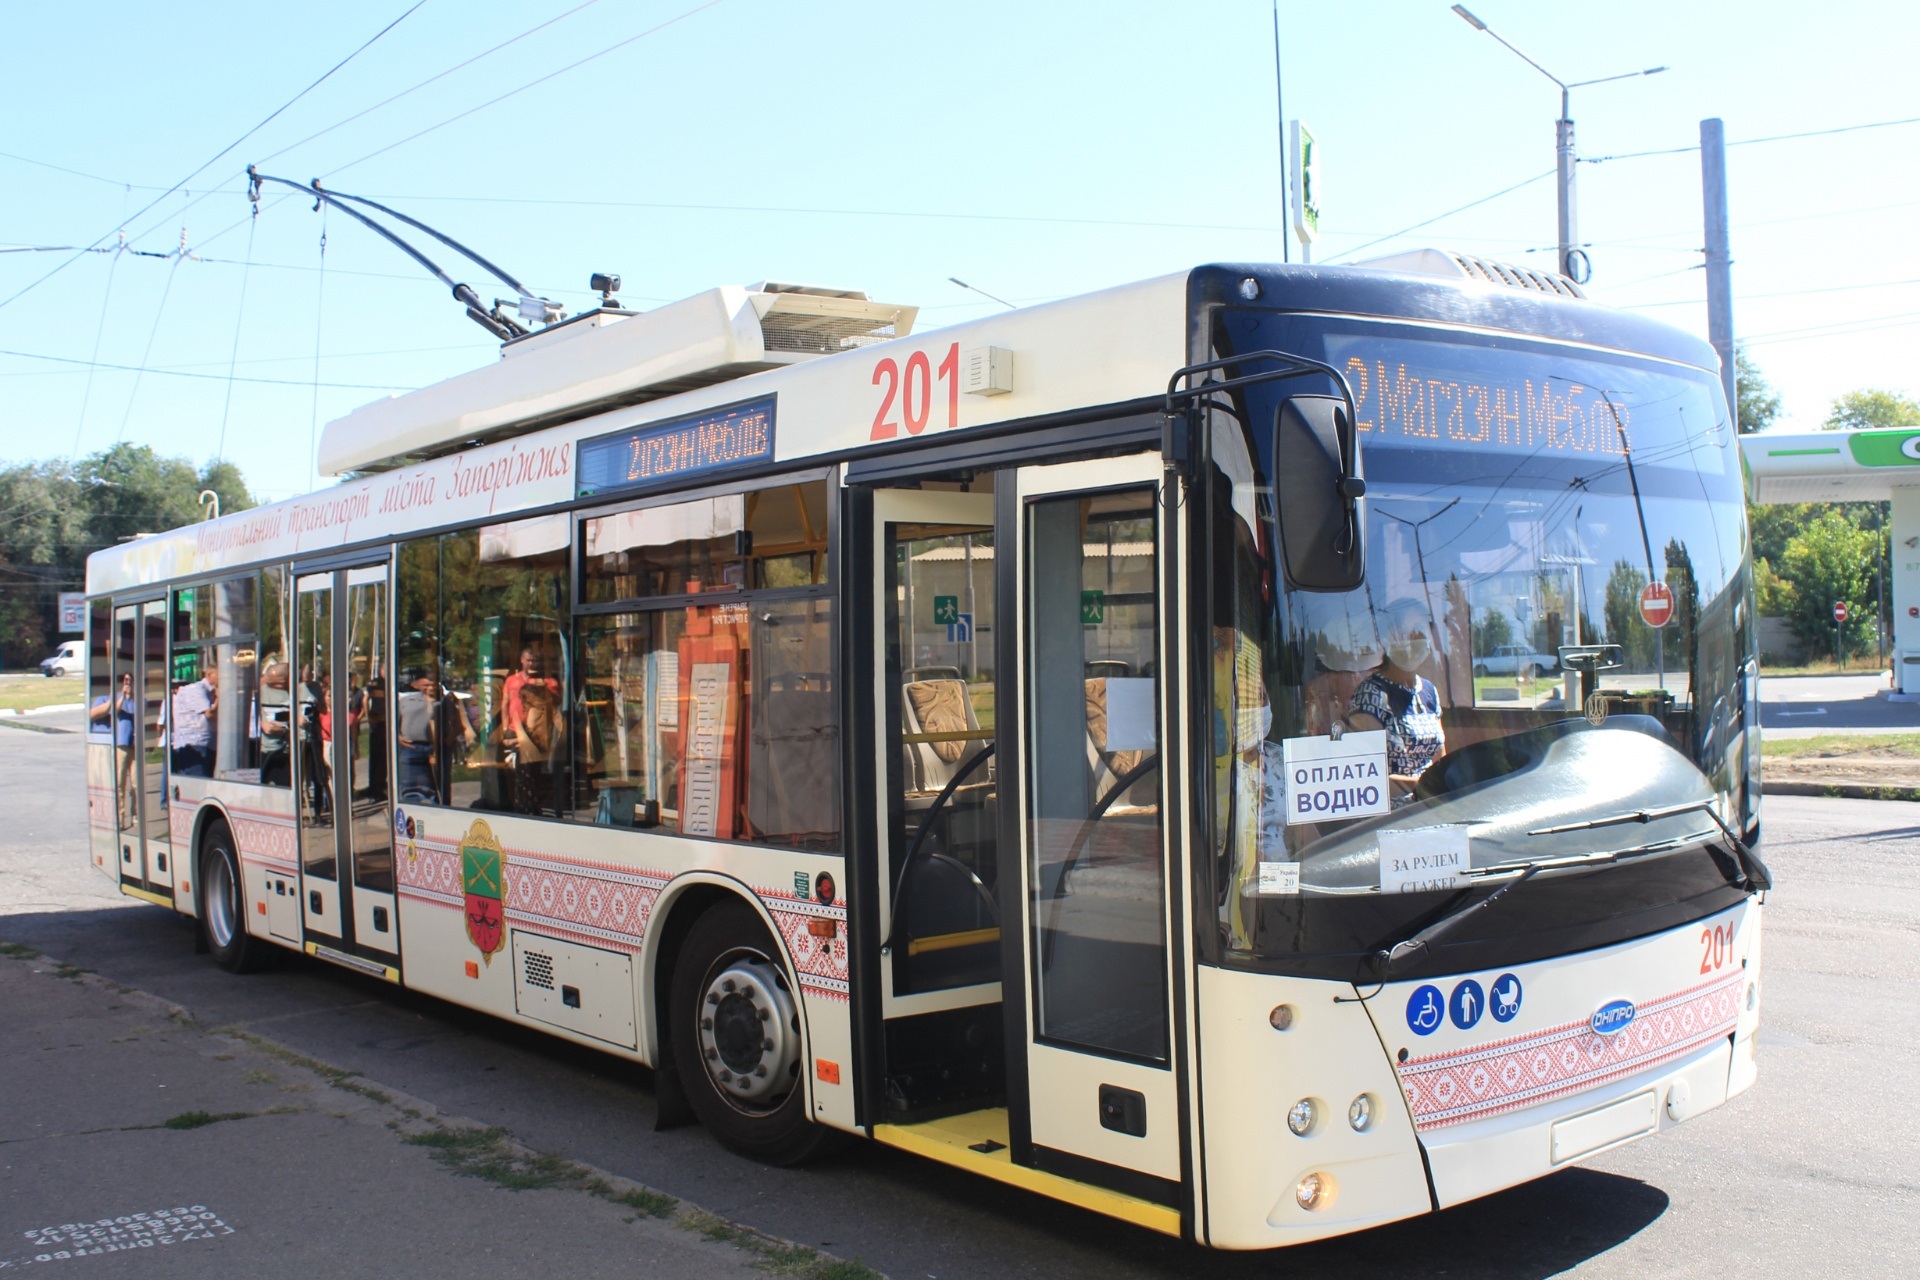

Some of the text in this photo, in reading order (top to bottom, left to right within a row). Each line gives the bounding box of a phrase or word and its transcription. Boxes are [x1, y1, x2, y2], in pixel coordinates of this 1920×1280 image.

[870, 342, 960, 441] 201
[1346, 357, 1631, 456] 2 Магазин Меблів
[697, 409, 768, 466] Меблів
[287, 486, 373, 552] транспорт
[379, 472, 435, 514] міста
[445, 442, 572, 514] Запоріжжя
[1295, 762, 1379, 785] ОПЛАТА
[1297, 785, 1379, 814] ВОДІЮ
[1284, 878, 1294, 886] 20
[1392, 853, 1459, 872] ЗА РУЛЕМ
[1400, 876, 1457, 893] СТАЖЕР
[1700, 920, 1735, 975] 201
